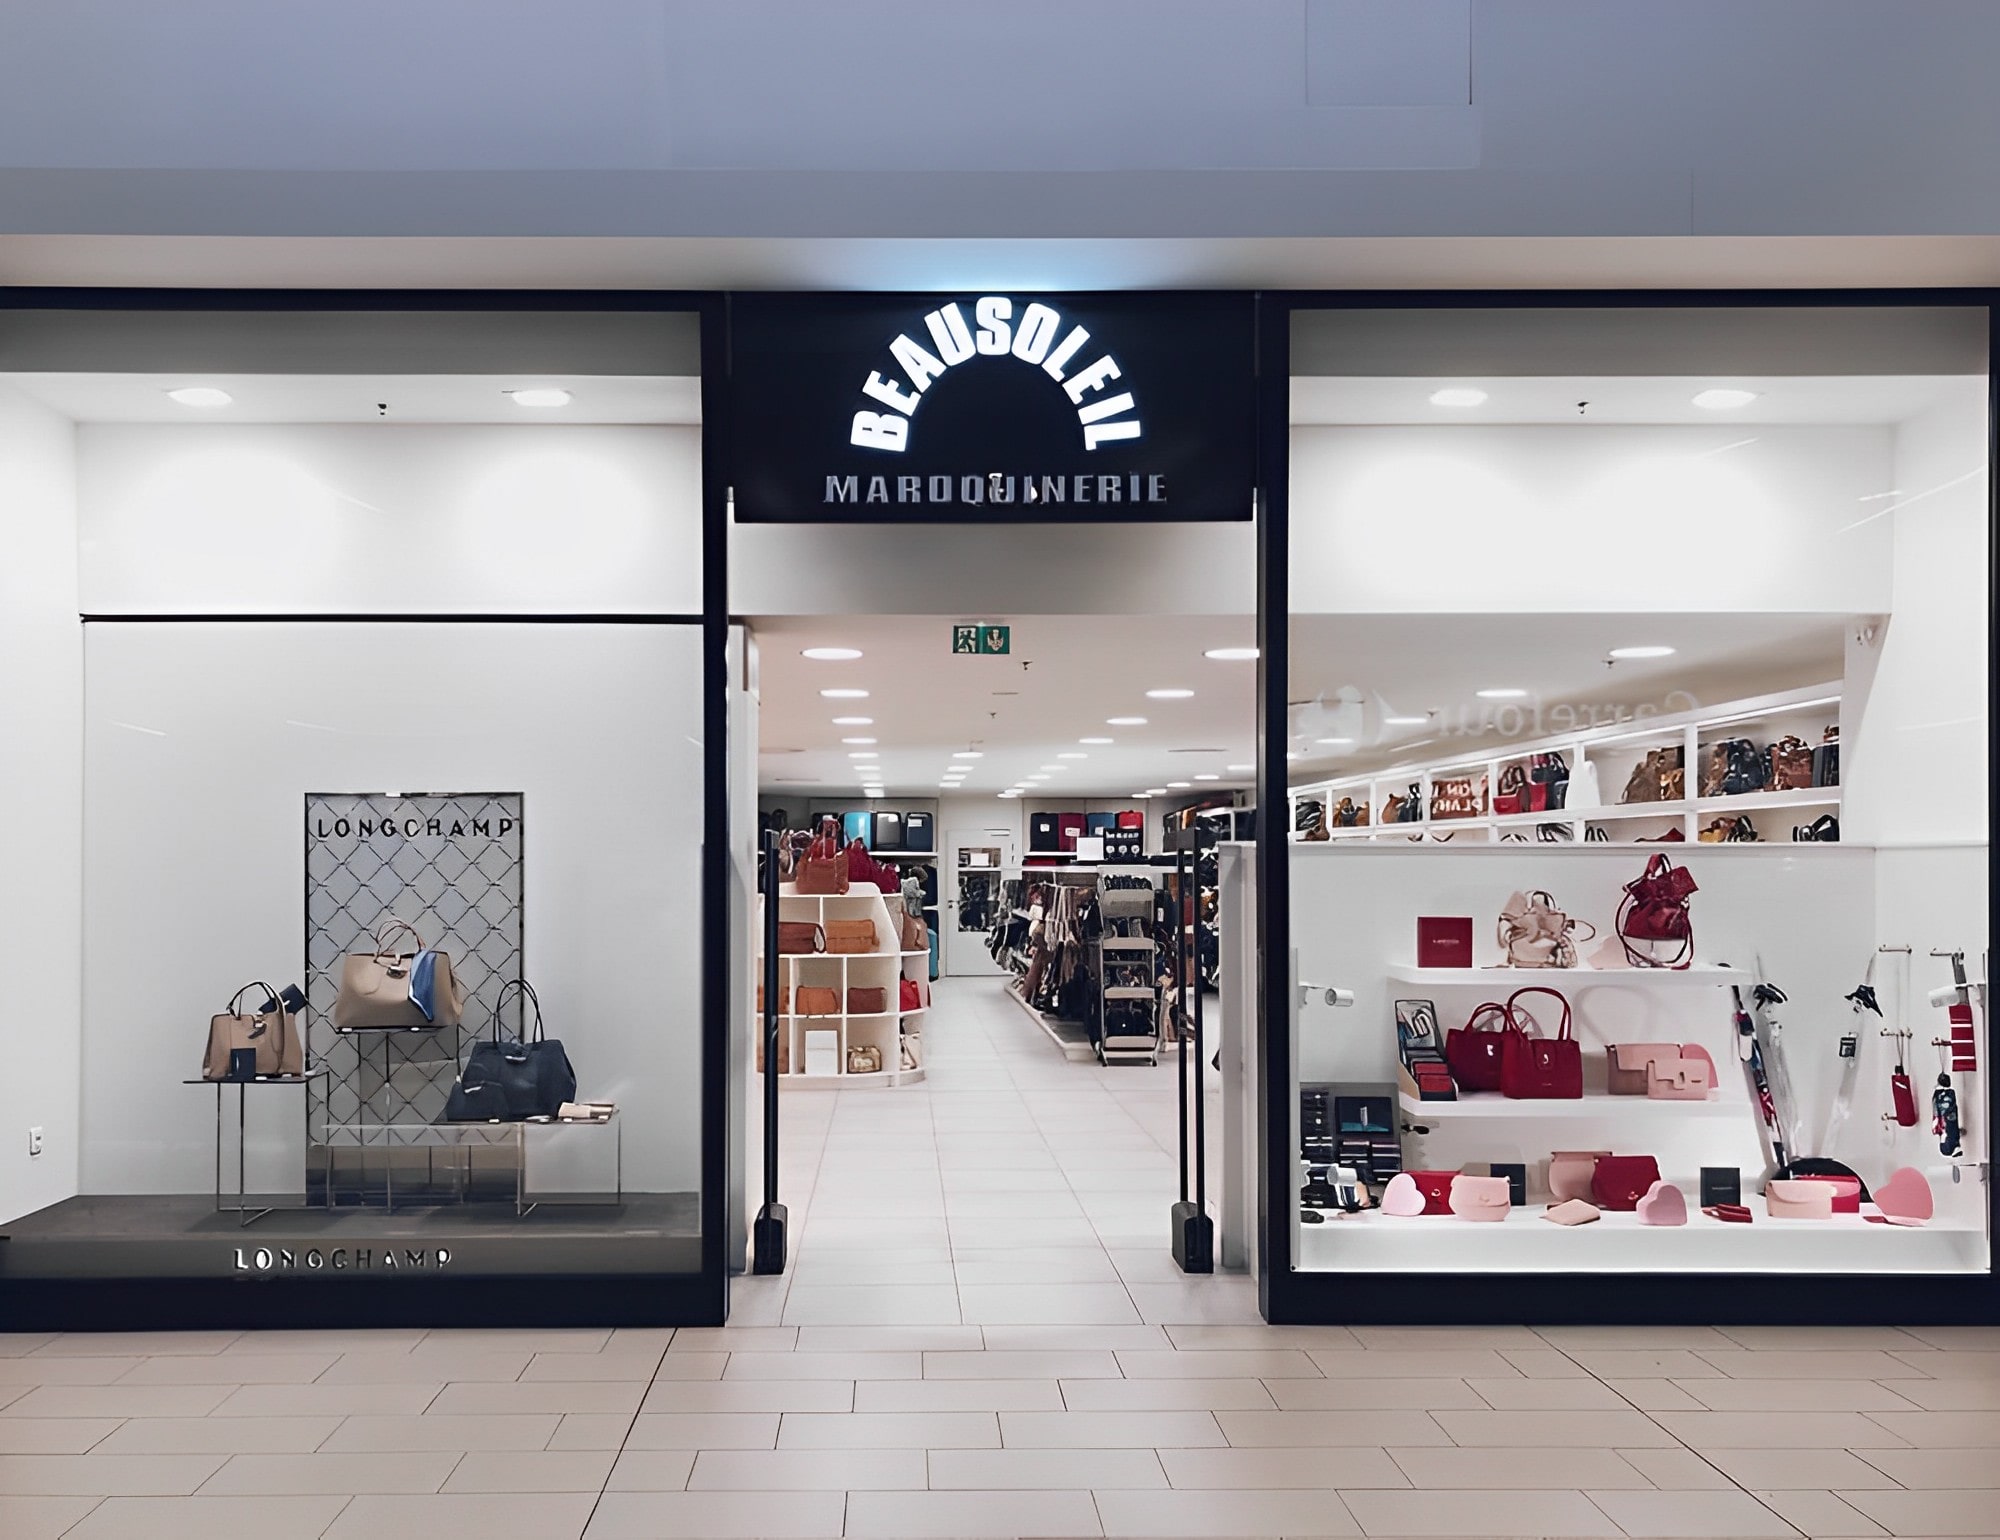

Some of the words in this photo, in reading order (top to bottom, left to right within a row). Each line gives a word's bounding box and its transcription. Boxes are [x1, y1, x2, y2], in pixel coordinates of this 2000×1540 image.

[850, 296, 1142, 452] BEAUSOLEIL
[824, 472, 1167, 506] MAROQUINERIE
[317, 817, 514, 838] LONGCHAMP
[234, 1247, 452, 1270] LONGCHAMP
